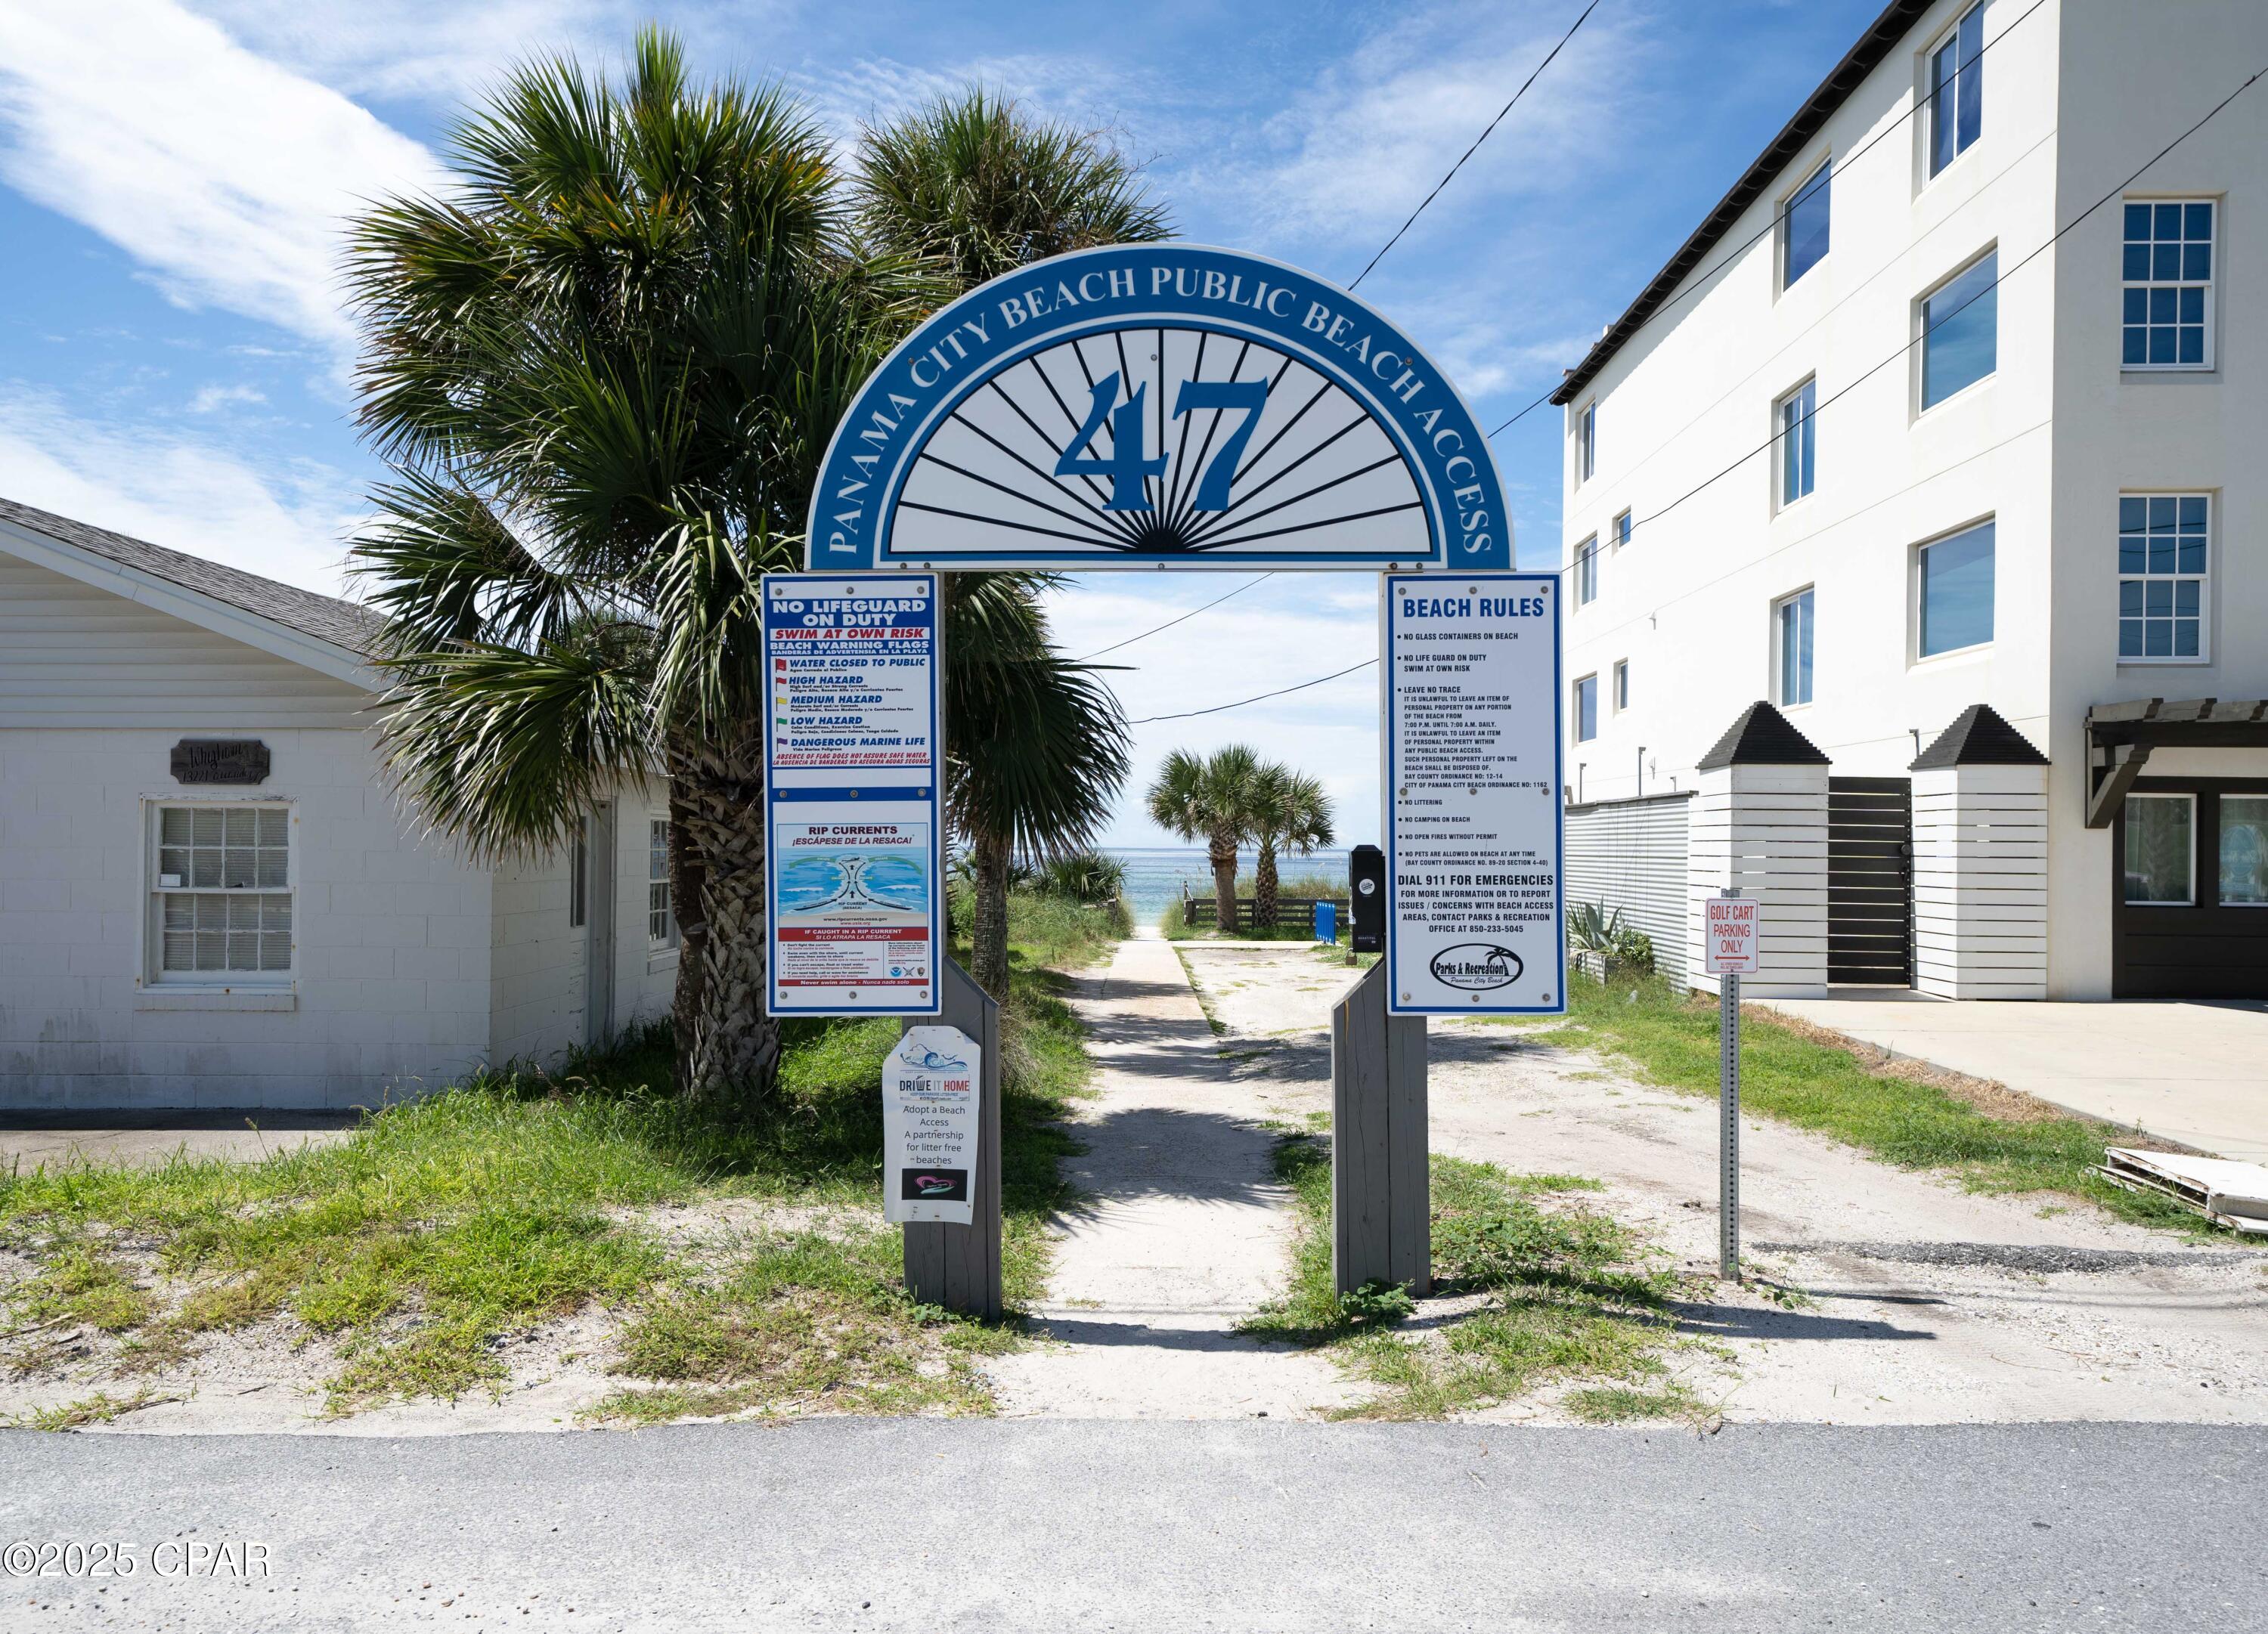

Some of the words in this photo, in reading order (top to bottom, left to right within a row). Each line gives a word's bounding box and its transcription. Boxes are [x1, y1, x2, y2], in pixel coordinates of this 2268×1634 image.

[829, 392, 917, 555] PANAMA
[910, 313, 991, 388] CITY
[998, 268, 1136, 330] BEACH
[1151, 267, 1297, 317] PUBLIC
[1300, 301, 1426, 404] BEACH
[1413, 408, 1492, 554] ACCESS
[1054, 370, 1268, 512] 47
[773, 600, 804, 613] NO
[813, 599, 925, 613] LIFEGUARD
[1403, 598, 1470, 617] BEACH
[1479, 597, 1544, 617] RULES
[802, 614, 834, 626] ON
[842, 613, 896, 626] DUTY
[775, 629, 817, 639] SWIM
[823, 629, 842, 639] AT
[847, 628, 885, 639] OWN
[890, 628, 924, 638] RISK
[816, 641, 883, 649] WARNING
[888, 640, 928, 648] FLAGS
[789, 659, 826, 667] WATER
[829, 658, 868, 667] CLOSED
[872, 658, 885, 667] TO
[889, 658, 925, 667] PUBLIC
[789, 676, 816, 684] HIGH
[819, 676, 863, 684] HAZARD
[790, 695, 834, 704] MEDIUM
[838, 695, 882, 703] HAZARD
[790, 716, 815, 725] LOW
[818, 716, 863, 725] HAZARD
[791, 738, 856, 746] DANGEROUS
[860, 737, 901, 745] MARINE
[905, 737, 925, 745] LIFE
[809, 826, 828, 834] RIP
[832, 825, 897, 834] CURRENTS
[1398, 874, 1422, 885] DIAL
[1426, 874, 1444, 885] 911
[1450, 874, 1471, 885] FOR
[1476, 874, 1553, 885] EMERGENCIES
[1402, 913, 1429, 921] AREAS,
[1710, 905, 1730, 920] GOLF
[1733, 905, 1754, 920] CART
[1713, 924, 1750, 937] PARKING
[1721, 939, 1743, 953] ONLY
[1436, 962, 1455, 975] Parks
[1458, 962, 1462, 974] &
[1464, 962, 1504, 974] Recreation
[933, 1080, 941, 1091] IT
[944, 1080, 969, 1091] HOME
[903, 1105, 929, 1116] Adopt
[940, 1106, 965, 1114] Beach
[919, 1118, 949, 1126] Access
[912, 1130, 963, 1140] partnership
[906, 1143, 919, 1151] for
[922, 1143, 942, 1151] litter
[944, 1143, 961, 1152] free
[916, 1156, 952, 1165] beaches
